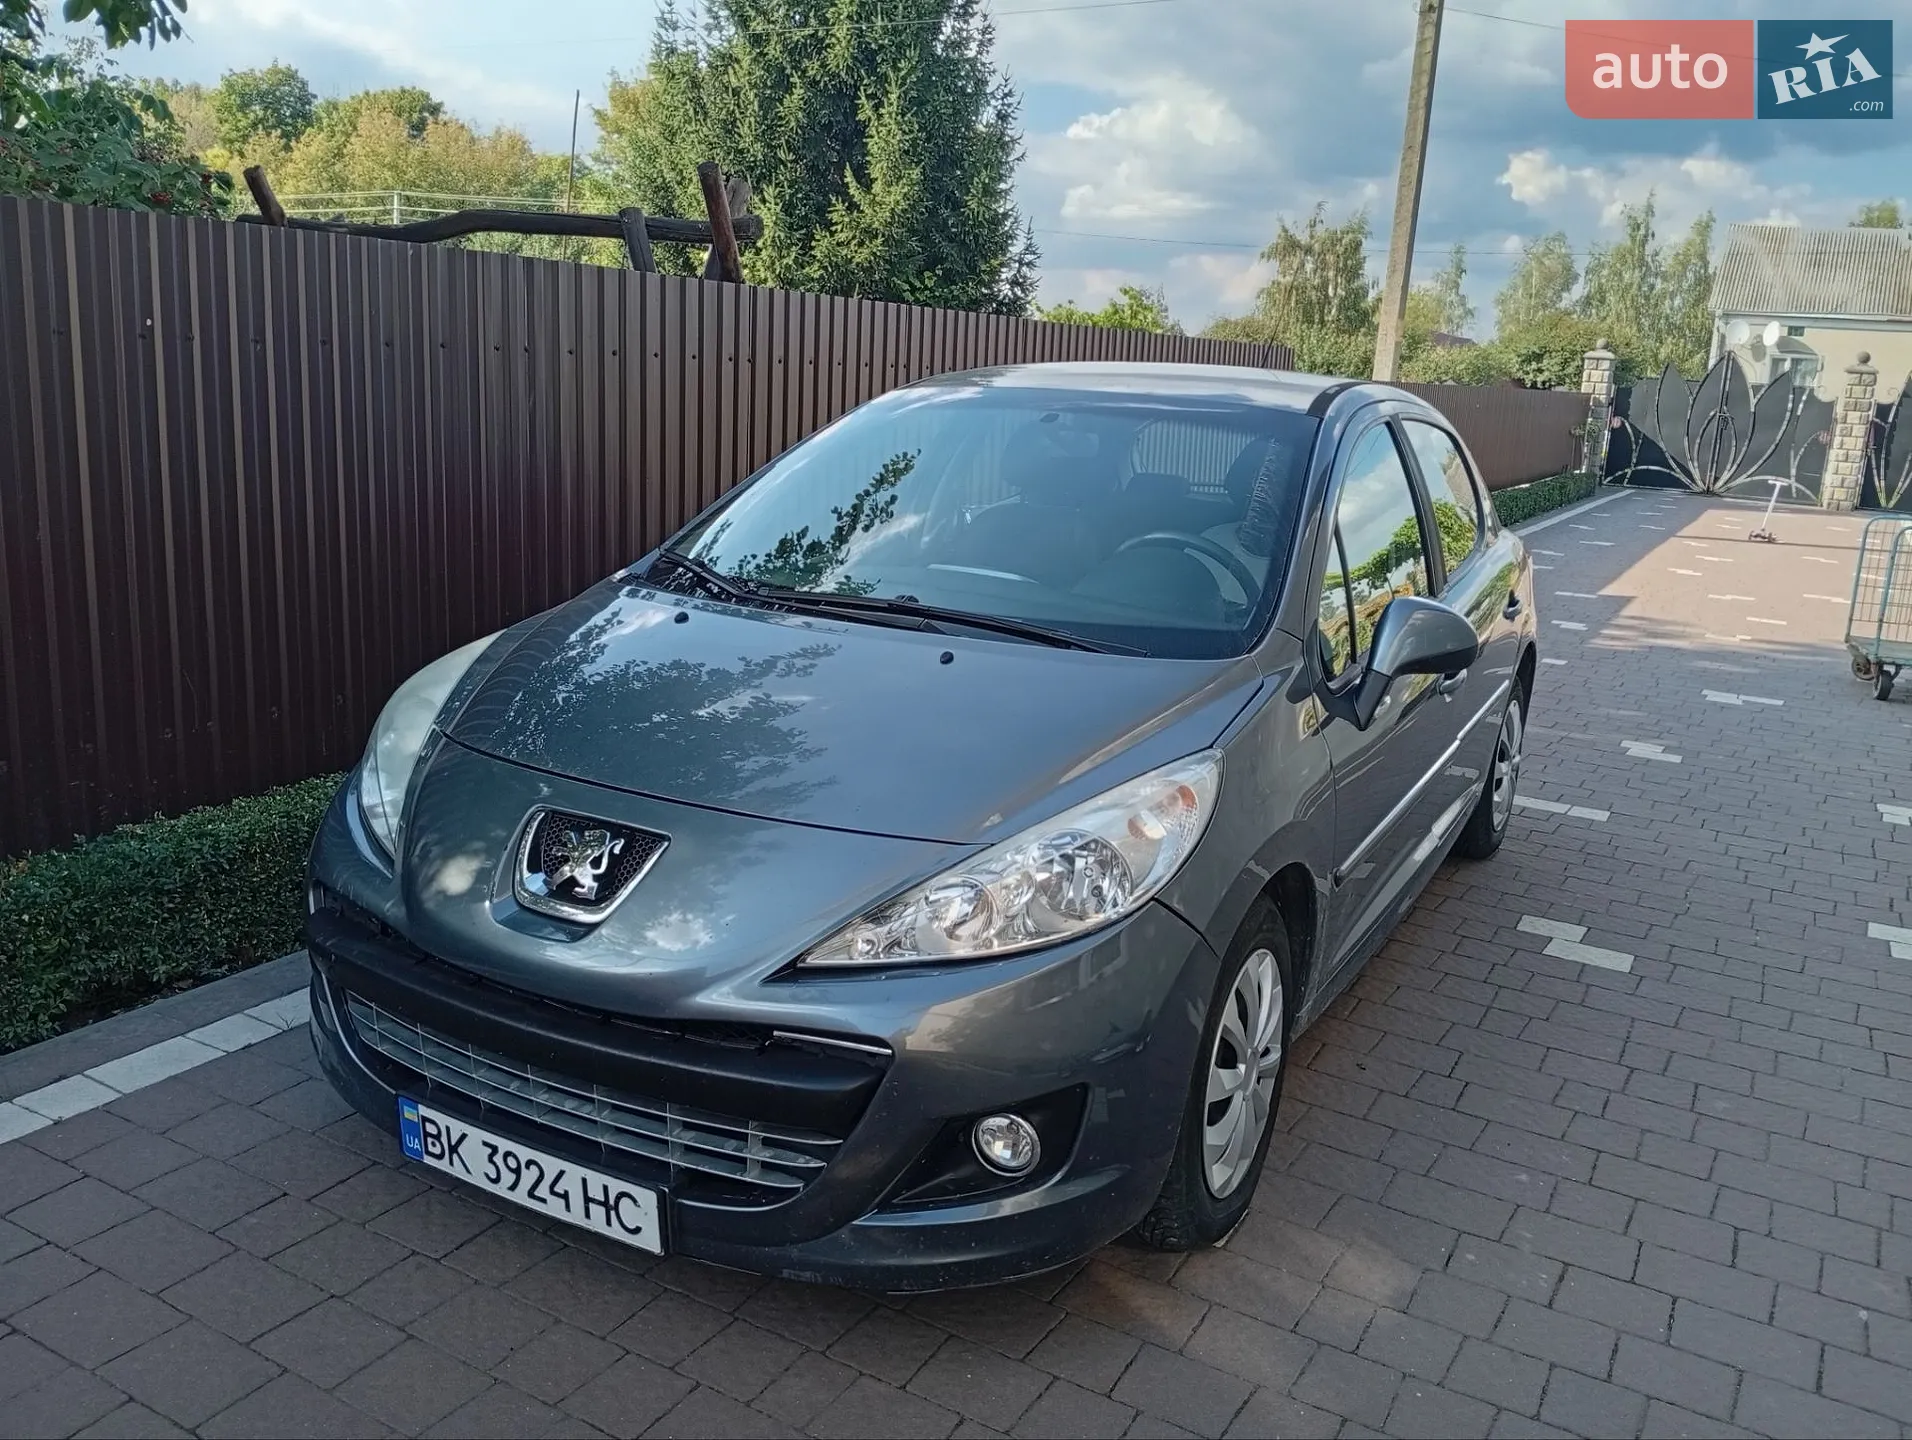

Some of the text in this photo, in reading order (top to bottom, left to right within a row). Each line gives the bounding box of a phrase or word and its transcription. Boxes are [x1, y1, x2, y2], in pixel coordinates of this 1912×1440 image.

[405, 1134, 421, 1152] UA
[420, 1114, 643, 1236] BK 3924 HC
